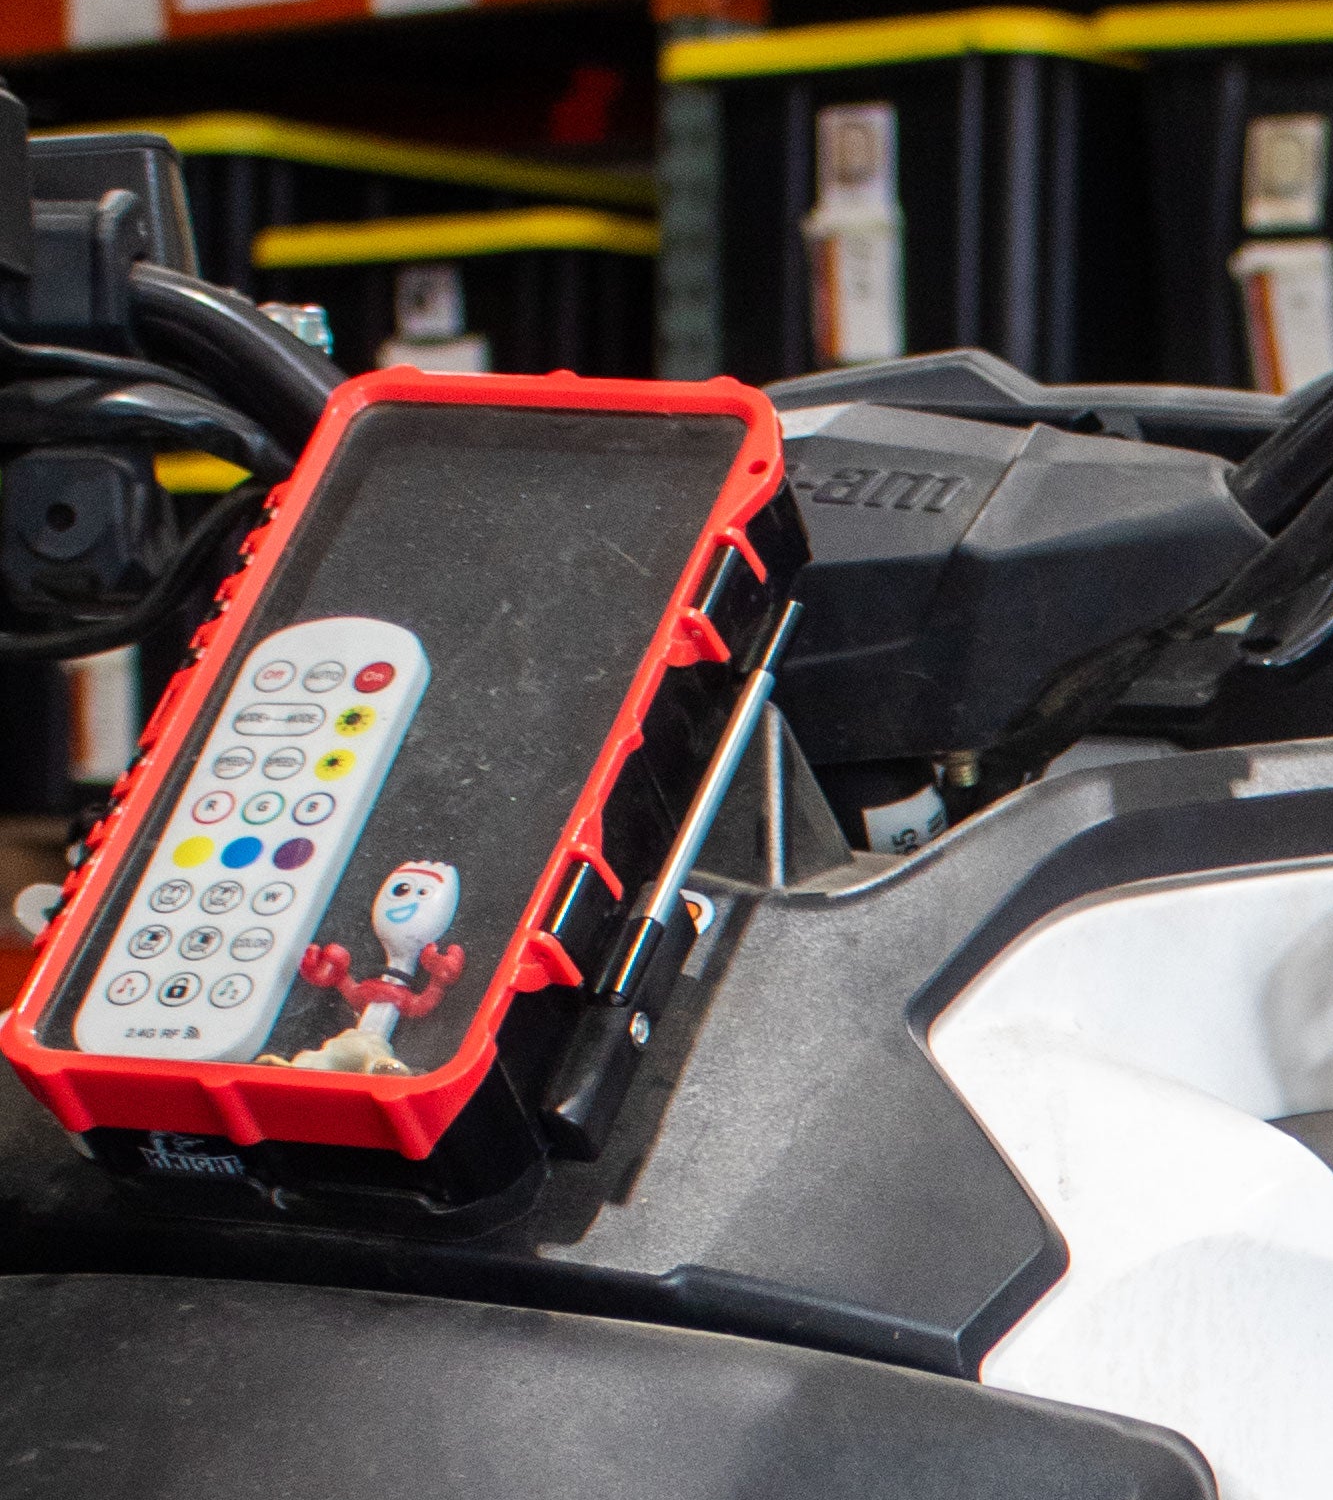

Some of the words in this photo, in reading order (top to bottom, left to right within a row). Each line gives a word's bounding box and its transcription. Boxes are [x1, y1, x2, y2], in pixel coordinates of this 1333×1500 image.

[205, 800, 217, 811] R
[256, 800, 270, 812] G
[306, 801, 319, 813] B
[264, 892, 282, 902] W
